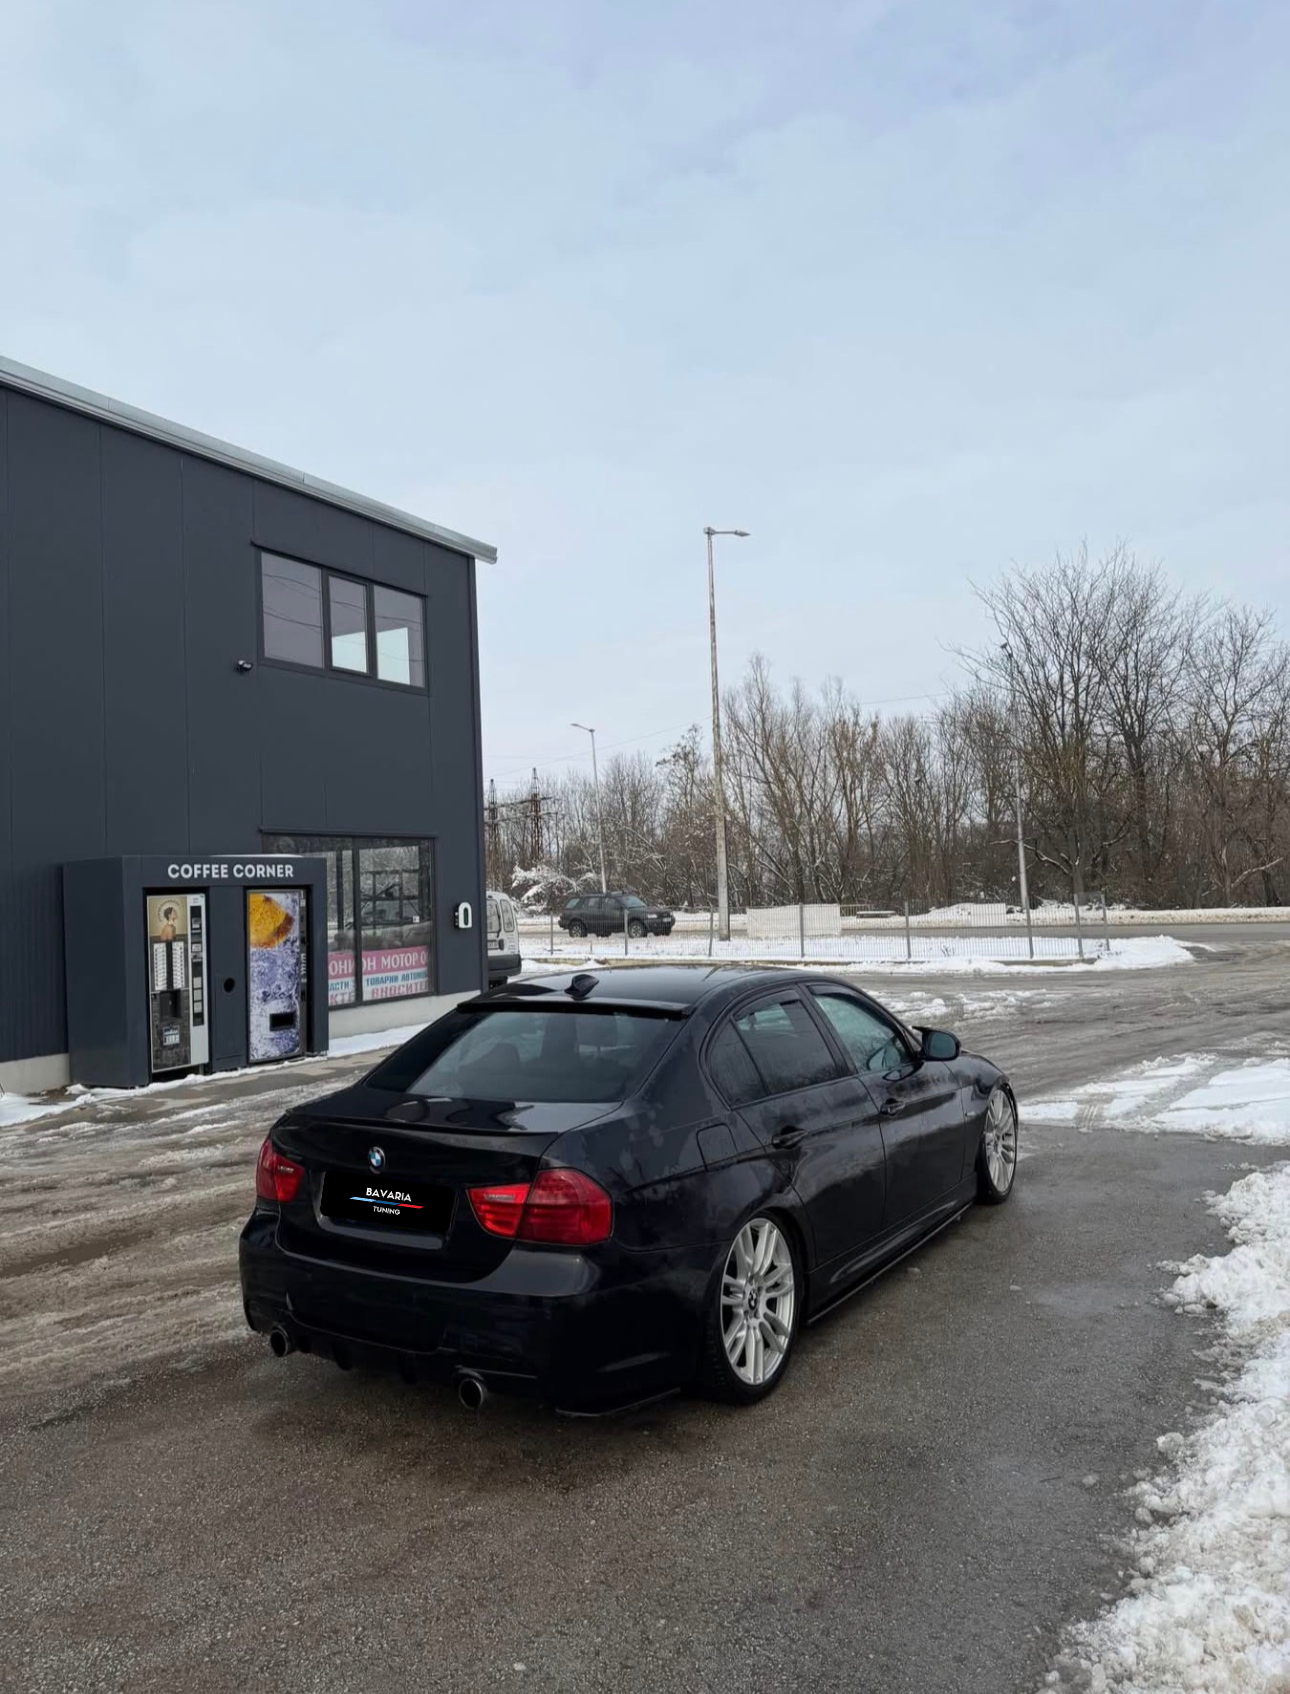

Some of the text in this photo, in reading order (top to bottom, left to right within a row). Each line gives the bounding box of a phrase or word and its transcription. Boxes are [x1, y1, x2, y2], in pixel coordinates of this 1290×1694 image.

[167, 864, 294, 879] COFFEE CORNER
[381, 952, 419, 969] МОТОР
